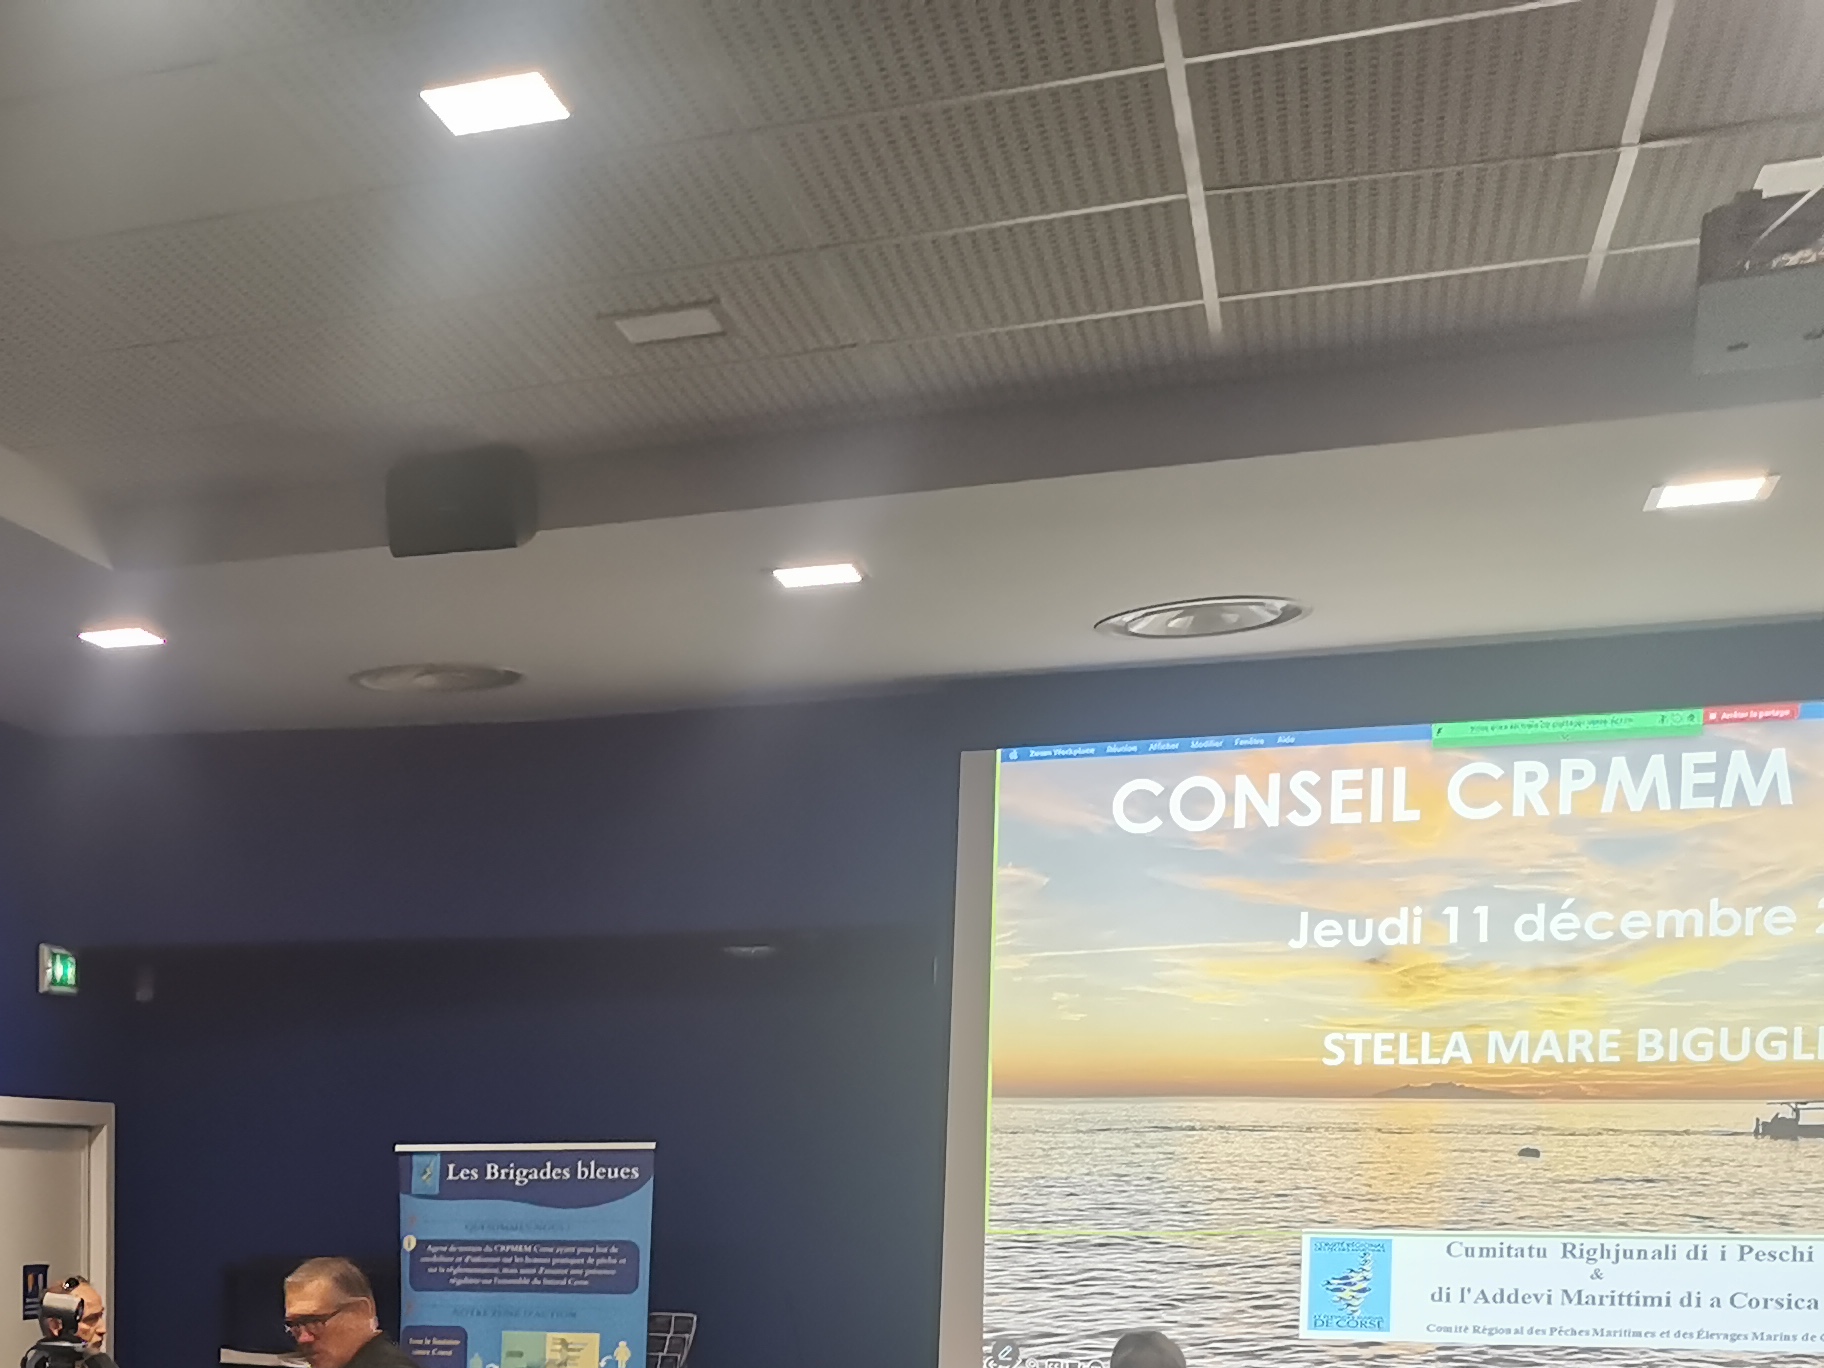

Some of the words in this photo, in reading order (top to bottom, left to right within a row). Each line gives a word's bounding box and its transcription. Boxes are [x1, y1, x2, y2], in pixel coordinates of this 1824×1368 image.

[1112, 766, 1422, 834] CONSEIL
[1447, 746, 1794, 820] CRPMEM
[1288, 905, 1423, 949] Jeudi
[1441, 905, 1489, 943] 11
[1514, 897, 1797, 943] décembre
[1321, 1031, 1473, 1066] STELLA
[1487, 1029, 1621, 1063] MARE
[446, 1163, 479, 1181] Les
[485, 1161, 571, 1186] Brigades
[577, 1160, 640, 1180] bleues
[1445, 1241, 1548, 1259] Cumitatu
[1560, 1242, 1677, 1265] Righjunali
[1685, 1243, 1709, 1262] di
[1719, 1244, 1727, 1262] i
[1737, 1244, 1815, 1263] Peschi
[1589, 1267, 1604, 1280] &
[1430, 1286, 1452, 1304] di
[1459, 1286, 1553, 1306] l'Addevi
[1559, 1288, 1672, 1308] Marittimi
[1679, 1291, 1702, 1308] di
[1709, 1296, 1722, 1309] a
[1729, 1292, 1820, 1310] Corsica
[1336, 1319, 1385, 1329] CORSE
[1426, 1323, 1469, 1334] Comité
[1472, 1325, 1525, 1337] Régional
[1527, 1326, 1547, 1336] des
[1548, 1325, 1591, 1337] Pêches
[1592, 1327, 1657, 1339] Maritimes
[1659, 1329, 1671, 1339] et
[1673, 1329, 1694, 1340] des
[1696, 1327, 1749, 1343] Élevages
[1751, 1331, 1797, 1342] Marins
[1801, 1332, 1818, 1343] de
